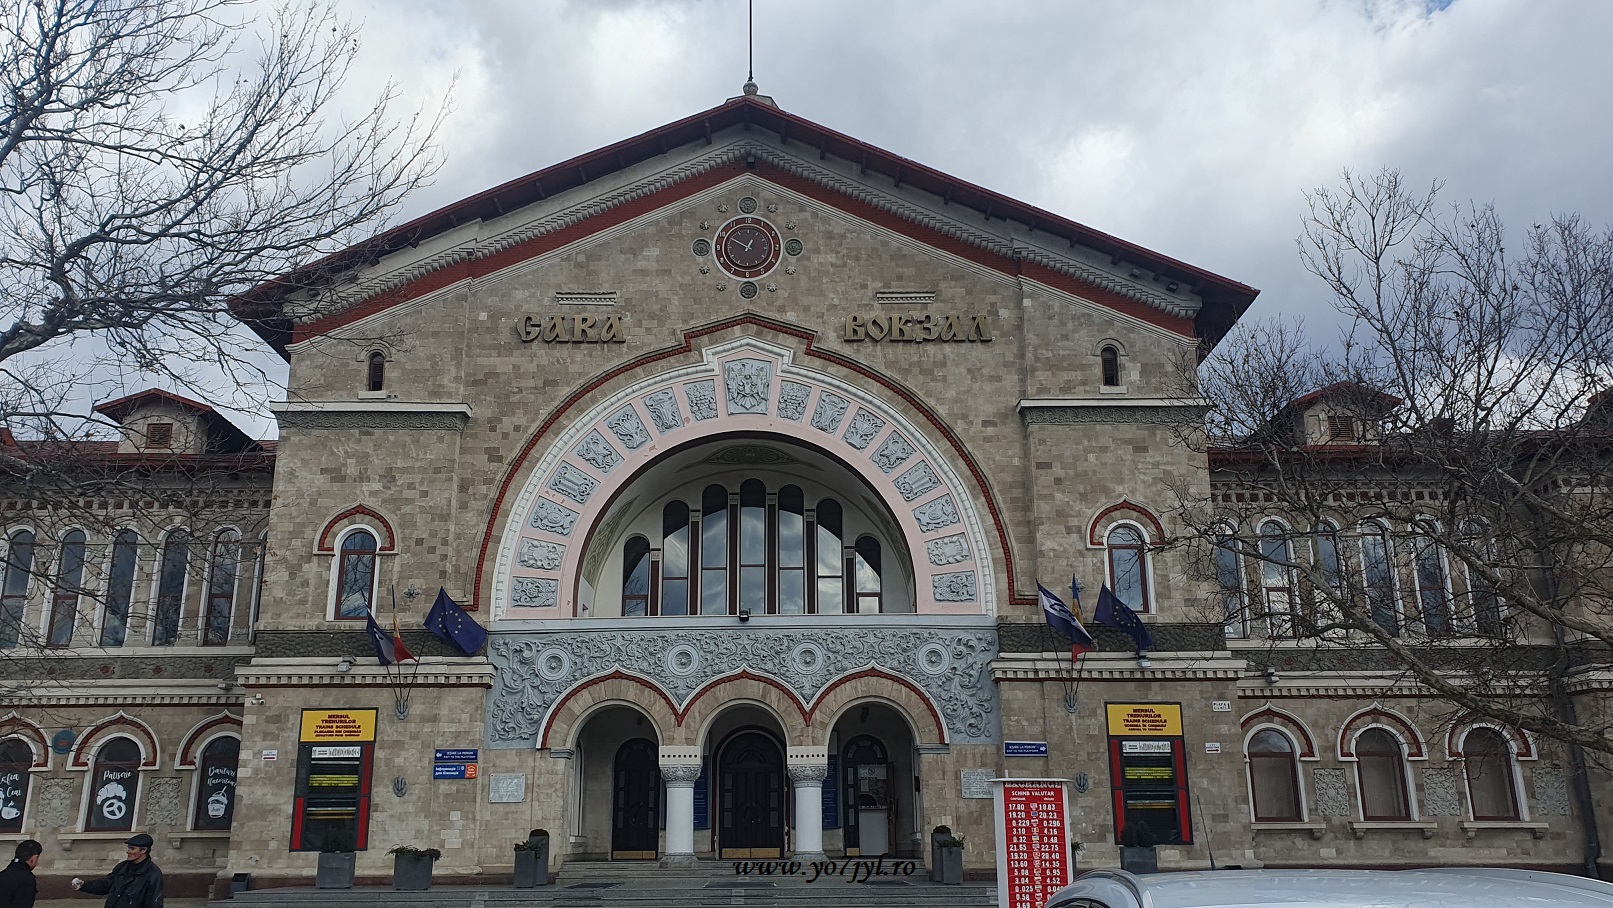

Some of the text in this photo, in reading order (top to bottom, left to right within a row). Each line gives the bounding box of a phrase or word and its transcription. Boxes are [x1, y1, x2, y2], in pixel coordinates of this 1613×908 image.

[516, 313, 626, 344] GARA
[843, 313, 994, 344] ВОКЗАЛ
[104, 770, 133, 780] Patiserie
